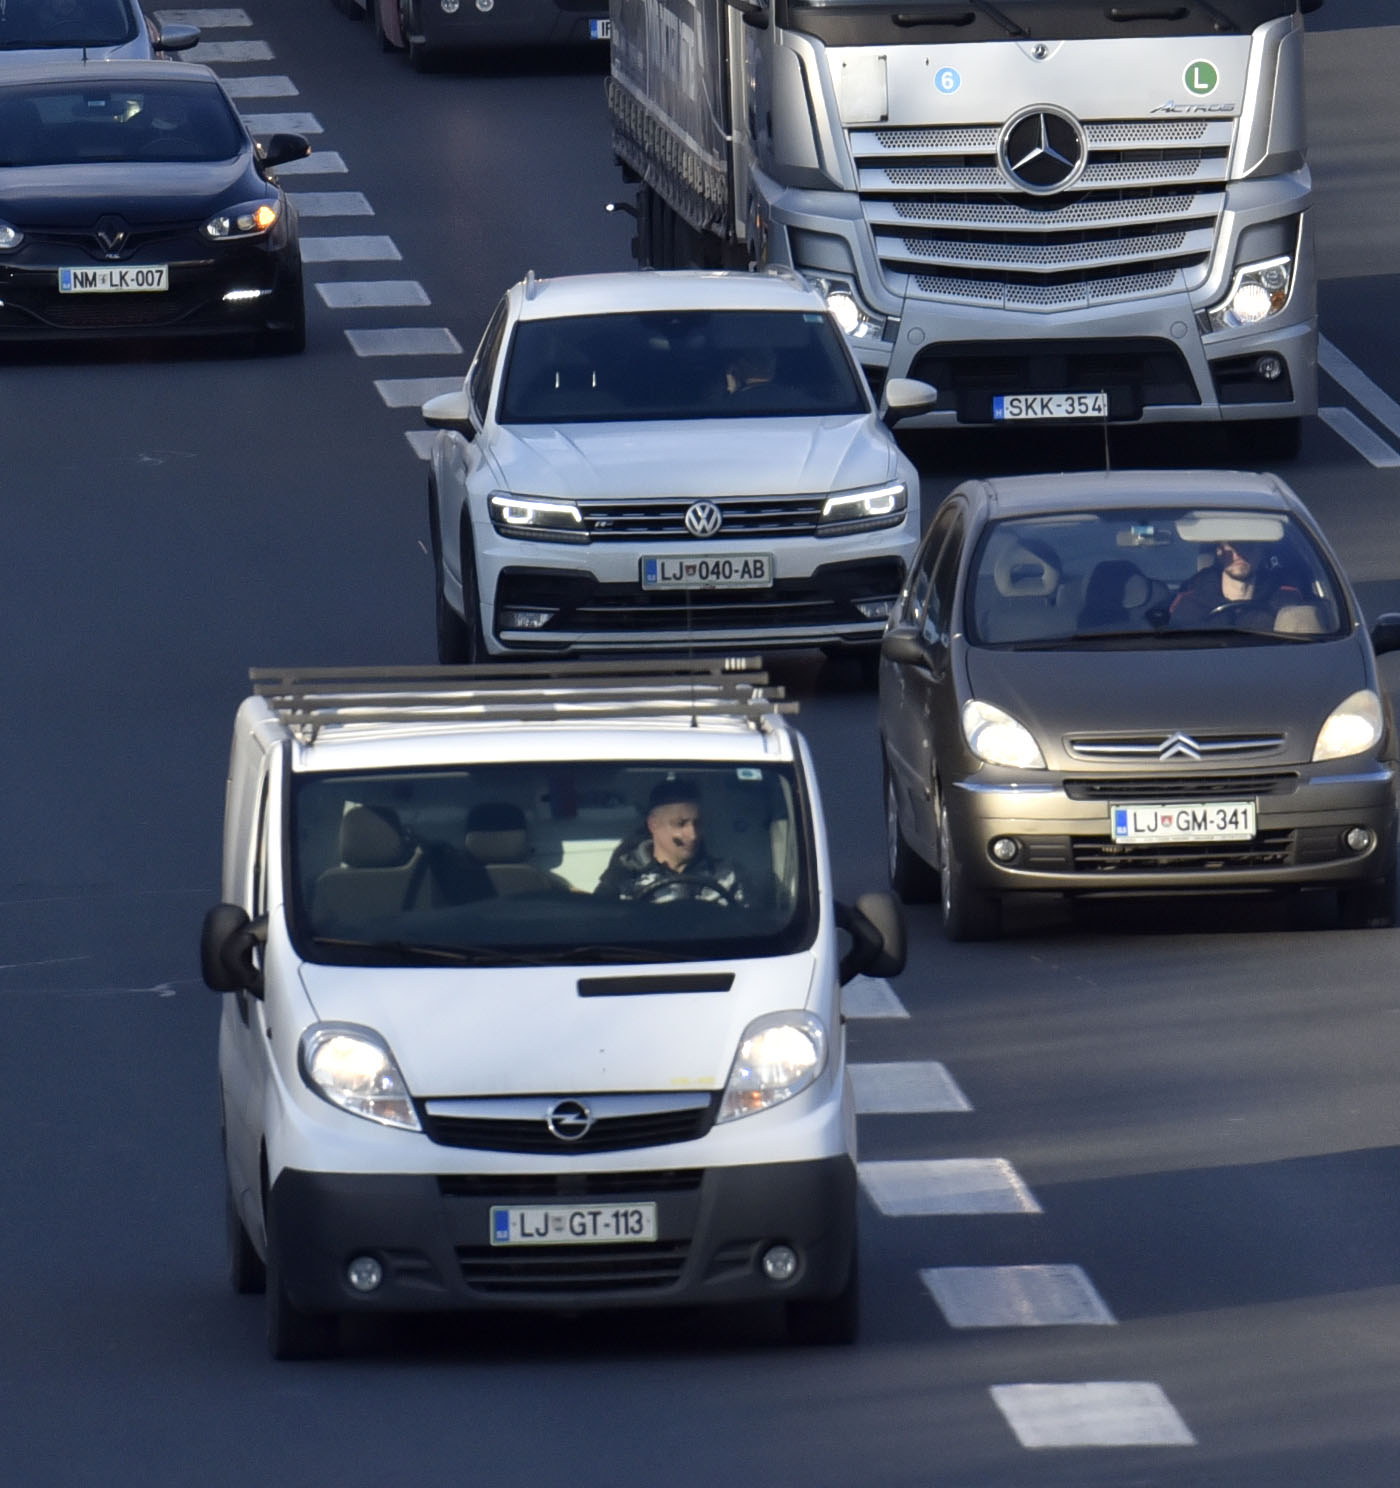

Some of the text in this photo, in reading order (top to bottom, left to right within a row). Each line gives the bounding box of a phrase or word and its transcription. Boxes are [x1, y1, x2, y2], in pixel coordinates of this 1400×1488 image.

[941, 71, 954, 90] 6
[1193, 66, 1209, 89] L
[73, 269, 164, 289] NM LK-007
[1009, 395, 1103, 417] SKK-354
[661, 559, 765, 581] LJ 040-AB
[1133, 808, 1249, 833] LJ GM-341
[520, 1209, 644, 1238] LJ GT-113
